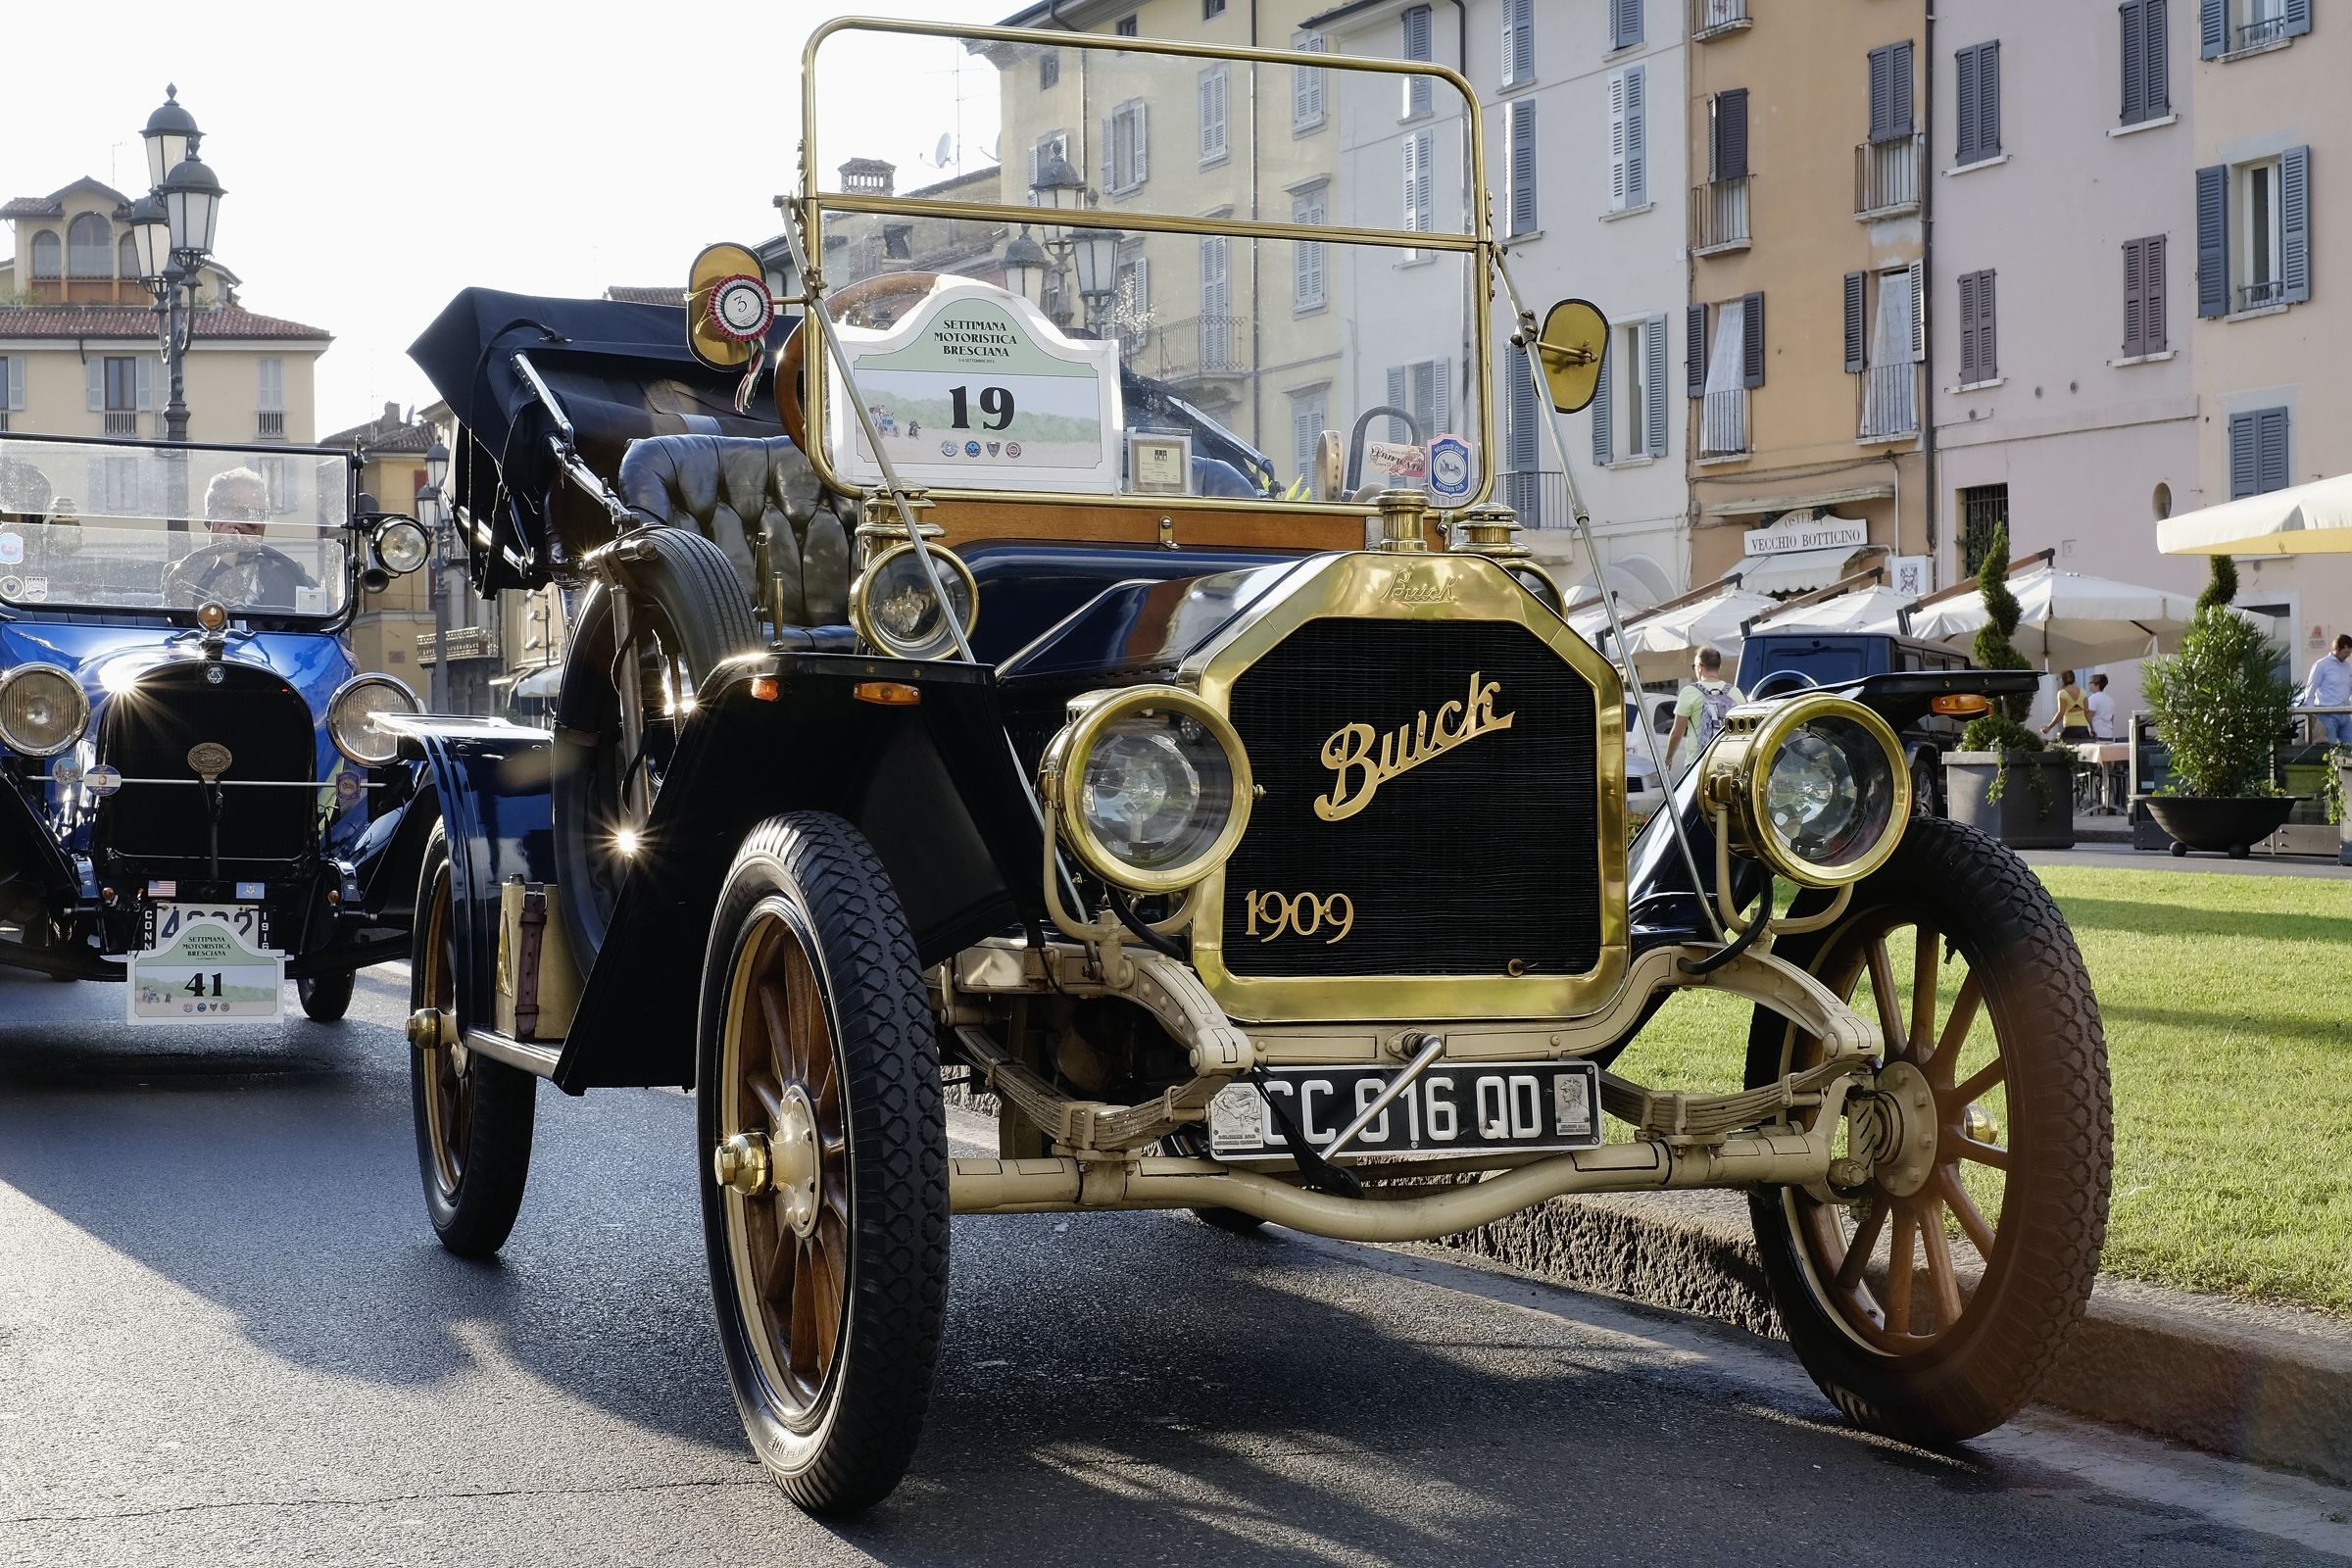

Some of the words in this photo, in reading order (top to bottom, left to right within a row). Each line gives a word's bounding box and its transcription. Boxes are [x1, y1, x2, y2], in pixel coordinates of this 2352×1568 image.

[733, 294, 748, 313] 3
[934, 332, 1017, 345] MOTORISTICA
[943, 319, 1007, 331] SETTIMANA
[943, 345, 1009, 357] BRESCIANA
[949, 385, 1015, 431] 19
[1455, 483, 1465, 492] CAR
[1751, 535, 1797, 552] VECCHIO
[1802, 529, 1861, 546] BOTTICINO
[1313, 670, 1516, 822] Buick
[161, 909, 253, 938] 42
[1244, 889, 1354, 944] 1909
[144, 910, 153, 951] CONN
[261, 911, 270, 950] 1916
[184, 972, 223, 998] 41
[1476, 1075, 1543, 1140] QD
